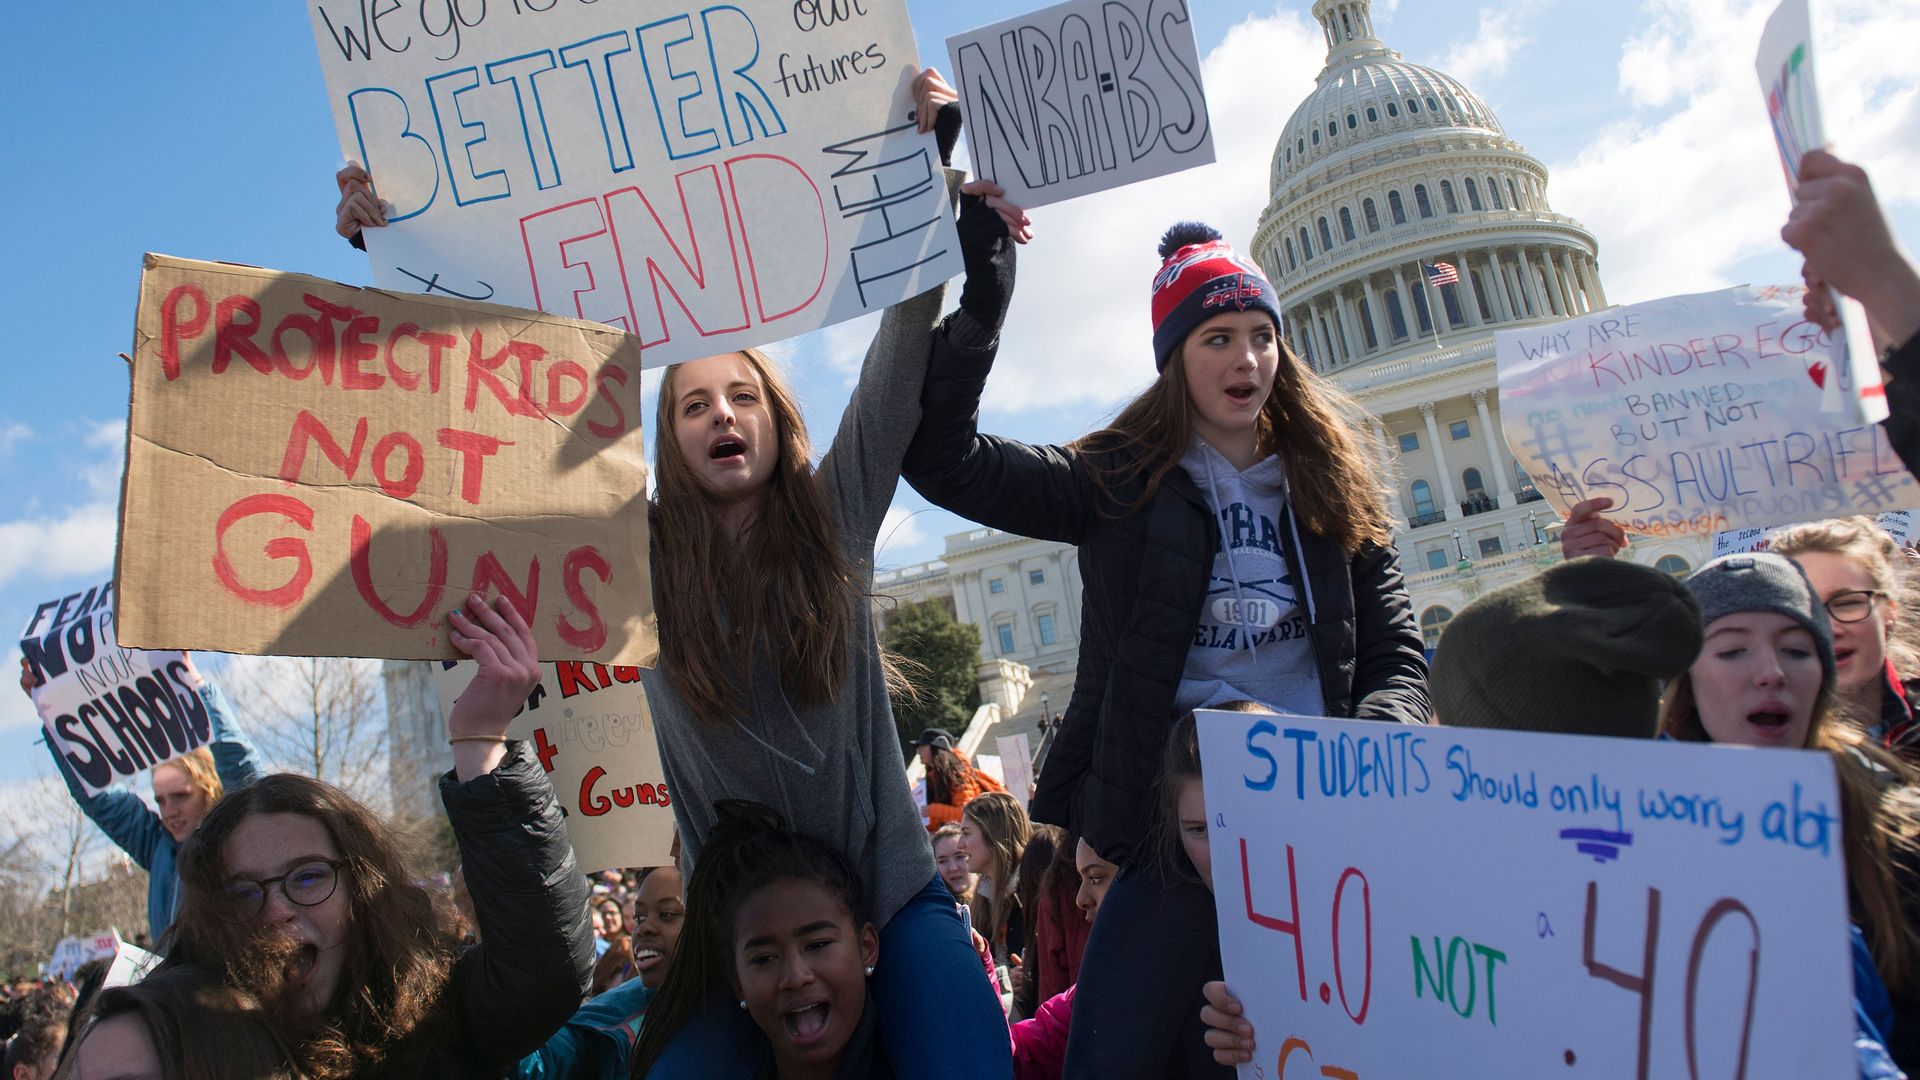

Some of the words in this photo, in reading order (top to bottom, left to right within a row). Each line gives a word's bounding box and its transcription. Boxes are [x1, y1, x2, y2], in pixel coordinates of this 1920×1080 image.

[774, 43, 886, 97] futures
[347, 5, 787, 224] BETTER
[520, 154, 830, 351] END
[158, 282, 457, 391] PROTECT
[464, 327, 629, 440] KIDS
[1518, 330, 1571, 361] WHY
[1588, 313, 1642, 348] ARE
[1587, 333, 1751, 388] KINDER
[1610, 417, 1688, 446] BUT
[1705, 401, 1765, 432] NOT
[1626, 382, 1745, 416] BANNED
[279, 409, 515, 505] NOT
[1784, 424, 1904, 487] RIFL
[212, 493, 614, 653] GUNS
[1194, 616, 1306, 650] ELAWARE
[55, 660, 210, 789] SCHOOLS
[578, 766, 671, 817] Guns
[1216, 812, 1228, 829] a
[1243, 720, 1430, 800] STUDENTS
[1550, 774, 1623, 833] only
[1639, 789, 1745, 846] worry
[1760, 780, 1841, 859] abt
[1239, 837, 1371, 1026] 4.0
[1537, 911, 1555, 939] a
[1411, 935, 1507, 1028] NOT
